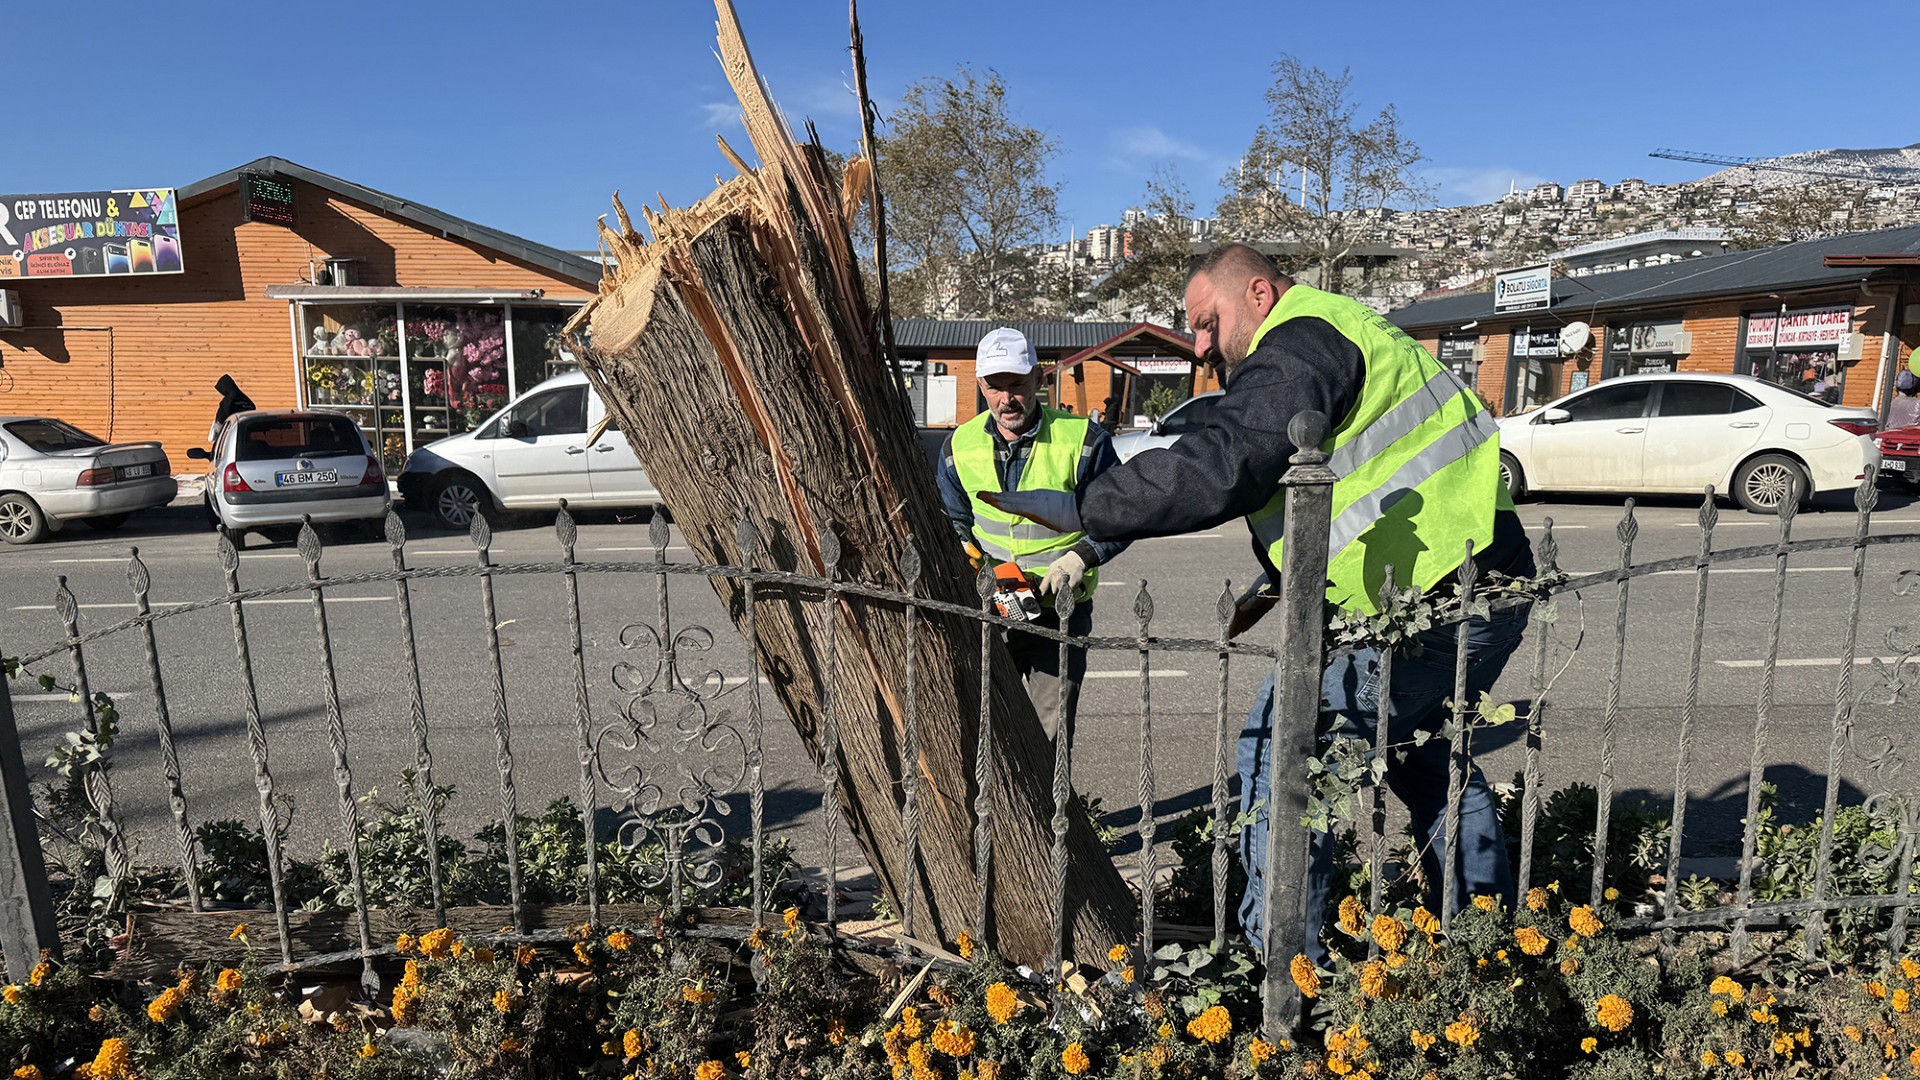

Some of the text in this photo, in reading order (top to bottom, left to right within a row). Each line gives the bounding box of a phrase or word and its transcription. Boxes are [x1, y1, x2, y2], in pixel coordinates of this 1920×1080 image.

[14, 197, 120, 220] CEP TELEFONU &
[23, 217, 152, 254] AKSESUAR DÜNYASI
[1781, 313, 1808, 331] ÇAKIR
[282, 473, 295, 484] 46
[297, 473, 313, 483] BM
[316, 471, 334, 482] 250
